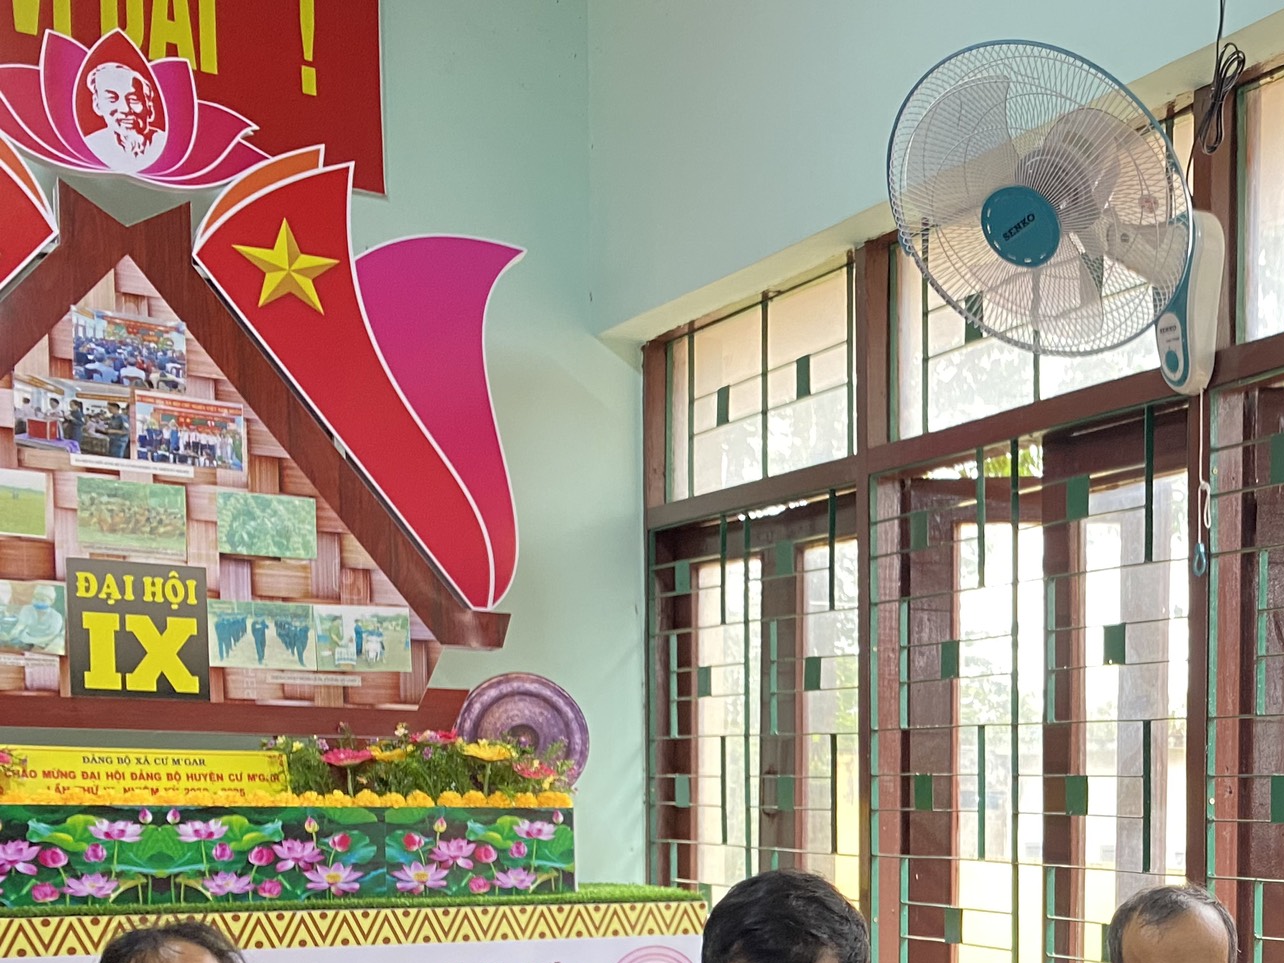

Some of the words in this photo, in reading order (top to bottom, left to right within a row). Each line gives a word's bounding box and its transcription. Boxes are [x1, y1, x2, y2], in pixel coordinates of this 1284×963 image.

[1003, 213, 1036, 242] SENKO
[76, 571, 135, 605] ĐẠI
[143, 570, 198, 610] HỘI
[82, 611, 199, 694] IX
